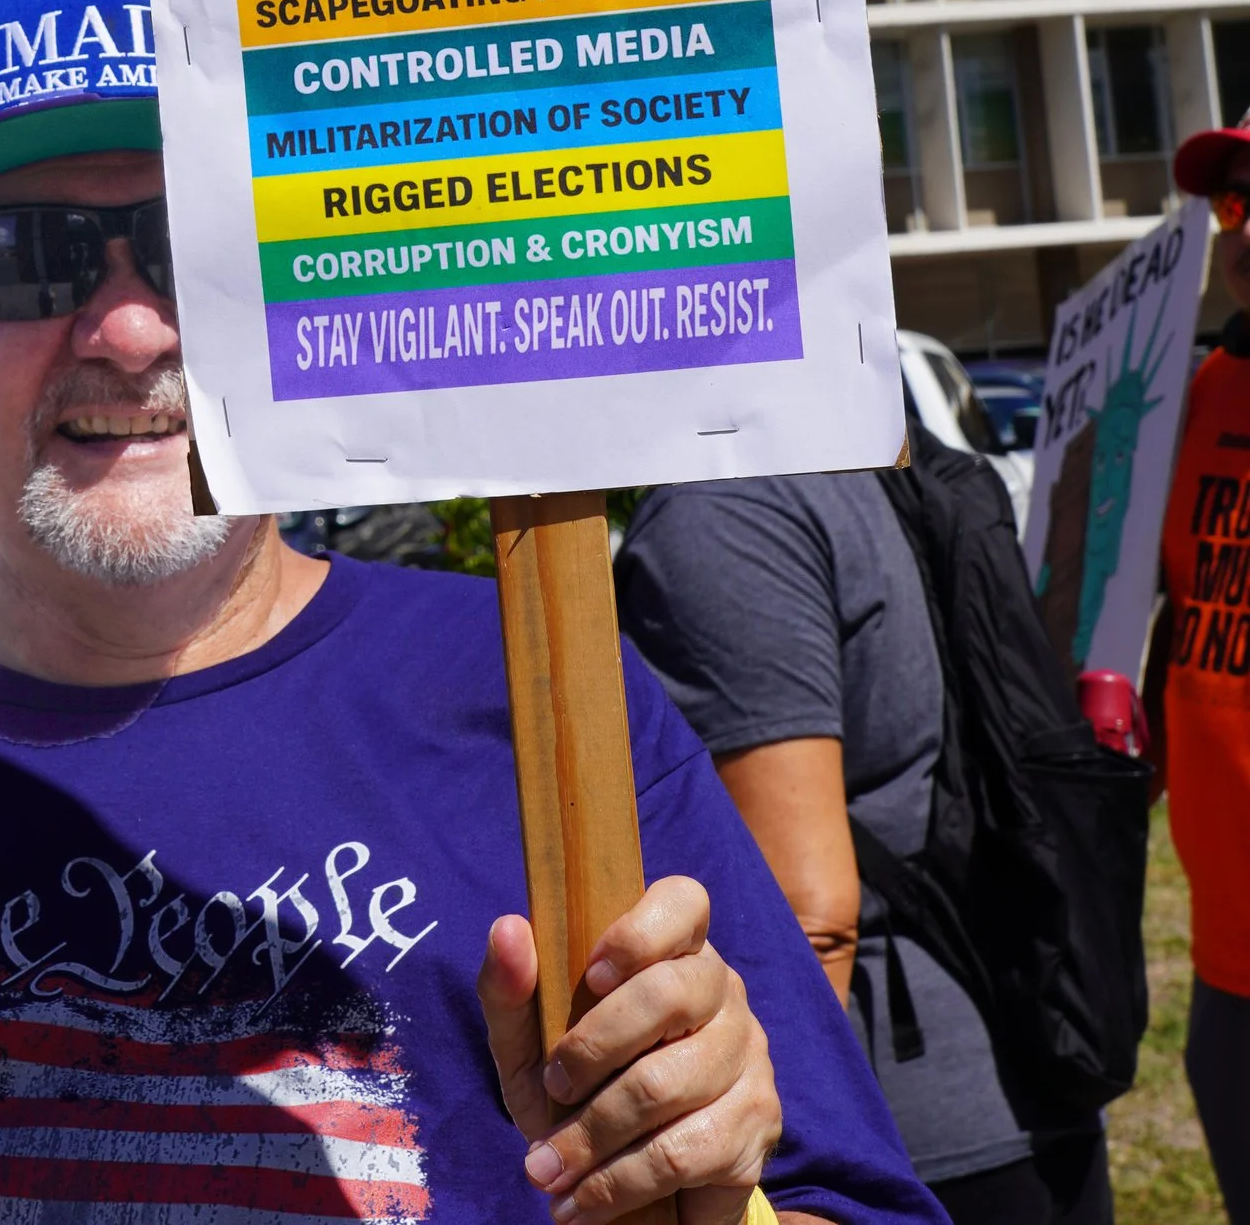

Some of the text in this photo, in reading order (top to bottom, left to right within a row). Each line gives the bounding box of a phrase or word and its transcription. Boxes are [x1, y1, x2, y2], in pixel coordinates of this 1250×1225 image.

[295, 24, 714, 93] CONTROLLED MEDIA
[268, 88, 749, 157] MILITARIZATION OF SOCIETY
[324, 155, 711, 218] RIGGED ELECTIONS
[294, 217, 751, 281] CORRUPTION & CRONYISM
[297, 279, 773, 370] STAY VIGILANT. SPEAK OUT. RESIST.
[1056, 312, 1080, 367] IS
[1044, 359, 1096, 450] YET?
[31, 841, 438, 1015] People
